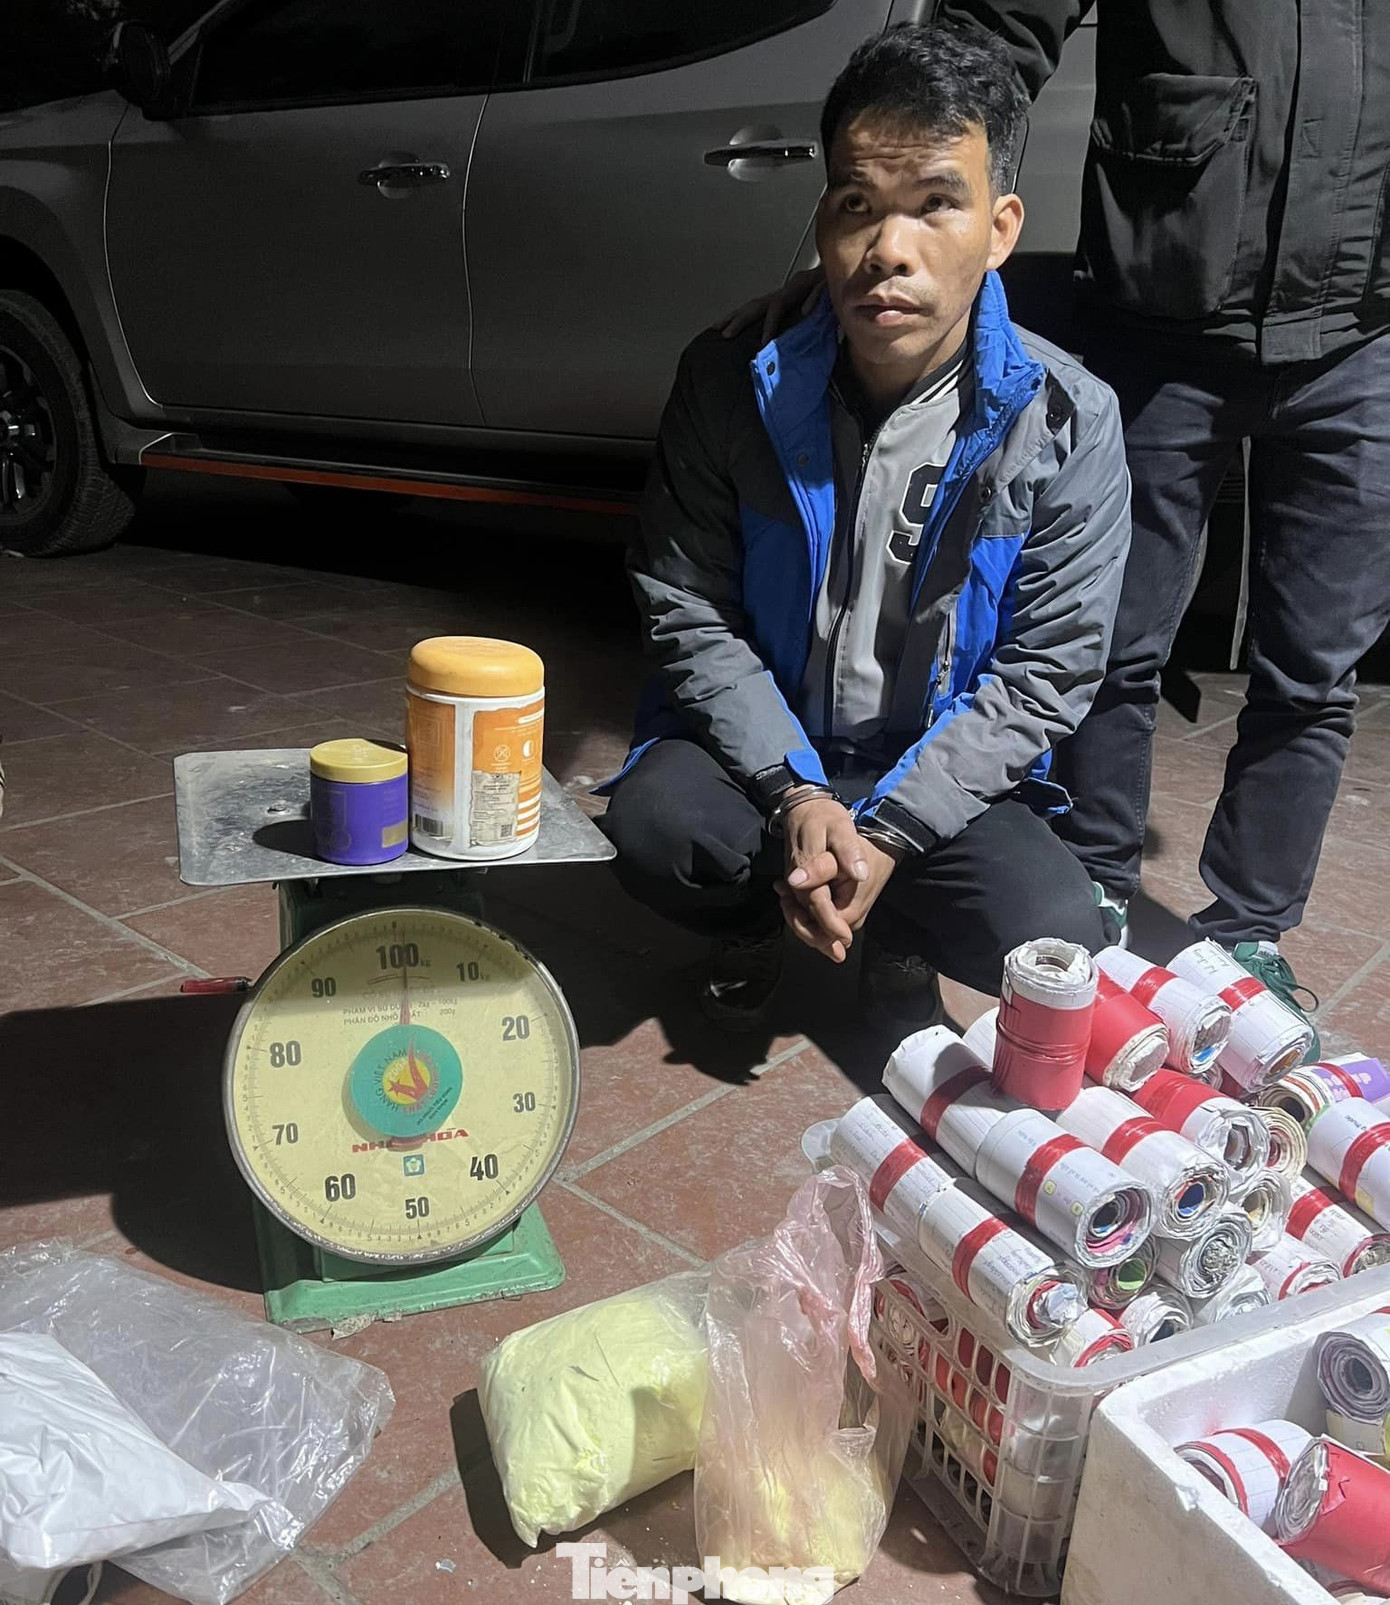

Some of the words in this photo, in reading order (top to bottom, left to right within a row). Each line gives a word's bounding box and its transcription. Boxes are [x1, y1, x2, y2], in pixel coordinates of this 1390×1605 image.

[376, 943, 419, 970] 100
[456, 962, 480, 982] 10
[311, 977, 337, 998] 90
[501, 1015, 530, 1041] 20
[270, 1041, 302, 1068] 80
[512, 1092, 536, 1113] 30
[272, 1122, 299, 1145] 70
[469, 1154, 499, 1182] 40
[324, 1173, 356, 1202] 60
[405, 1196, 430, 1220] 50
